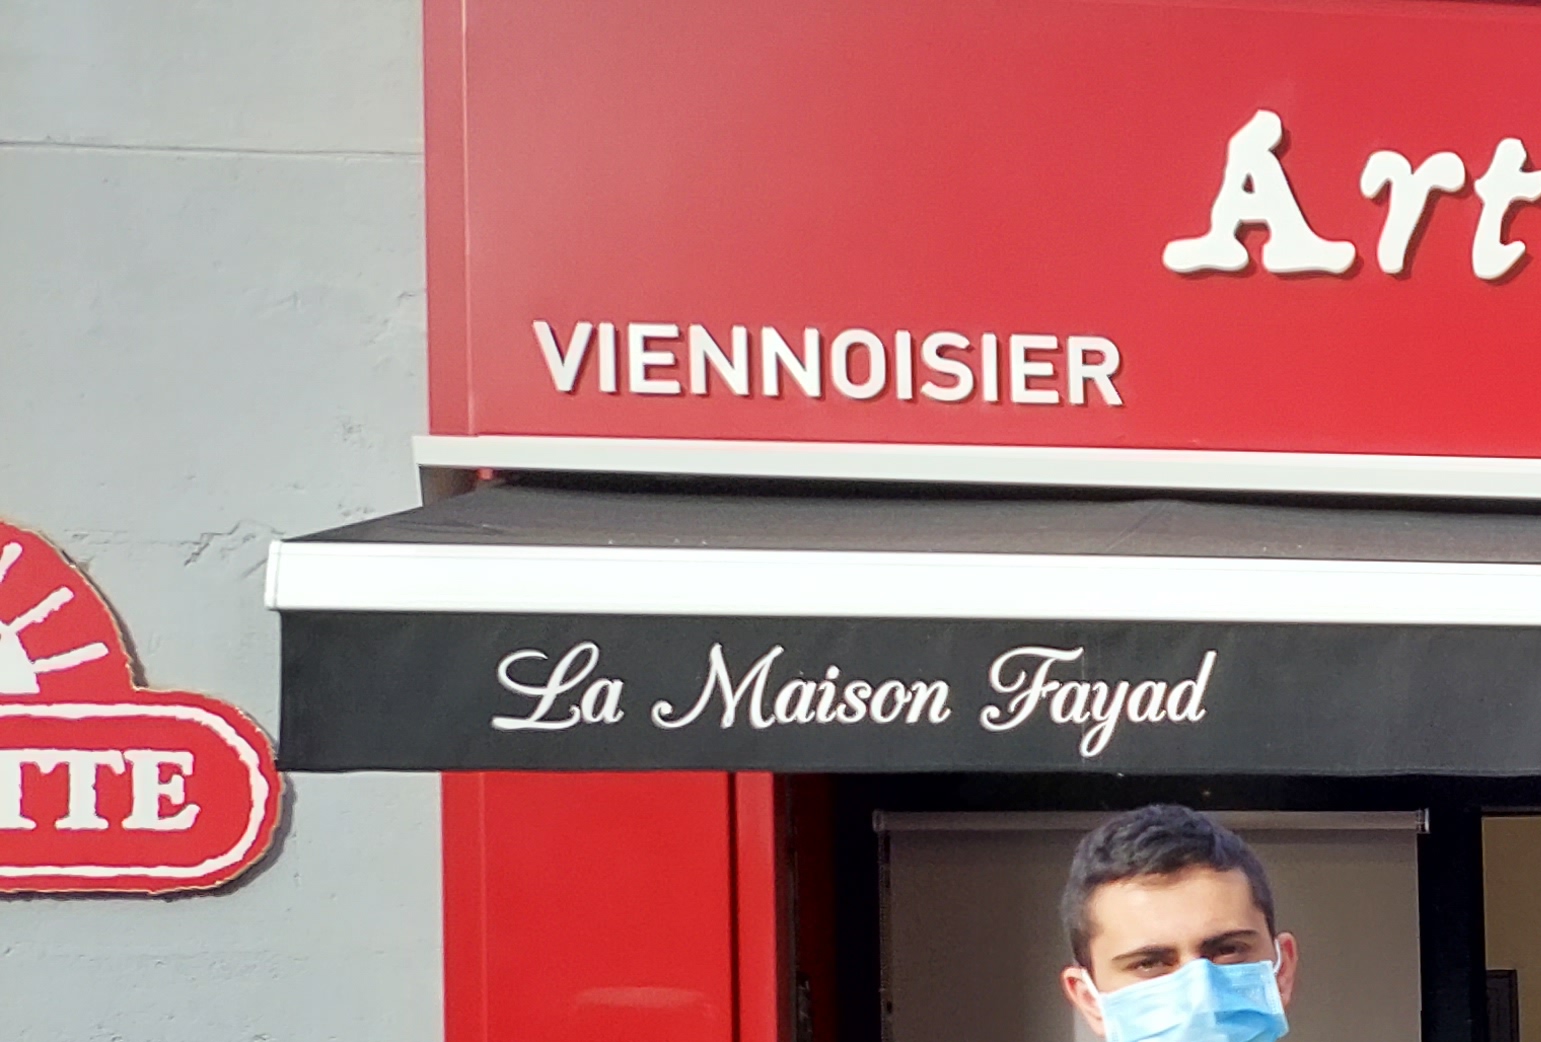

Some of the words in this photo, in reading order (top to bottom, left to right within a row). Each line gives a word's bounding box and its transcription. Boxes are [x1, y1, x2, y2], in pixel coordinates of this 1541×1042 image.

[533, 320, 1123, 406] VIENNOISIER
[491, 642, 625, 731] La
[651, 643, 952, 729] Maison
[980, 646, 1217, 758] Fayad
